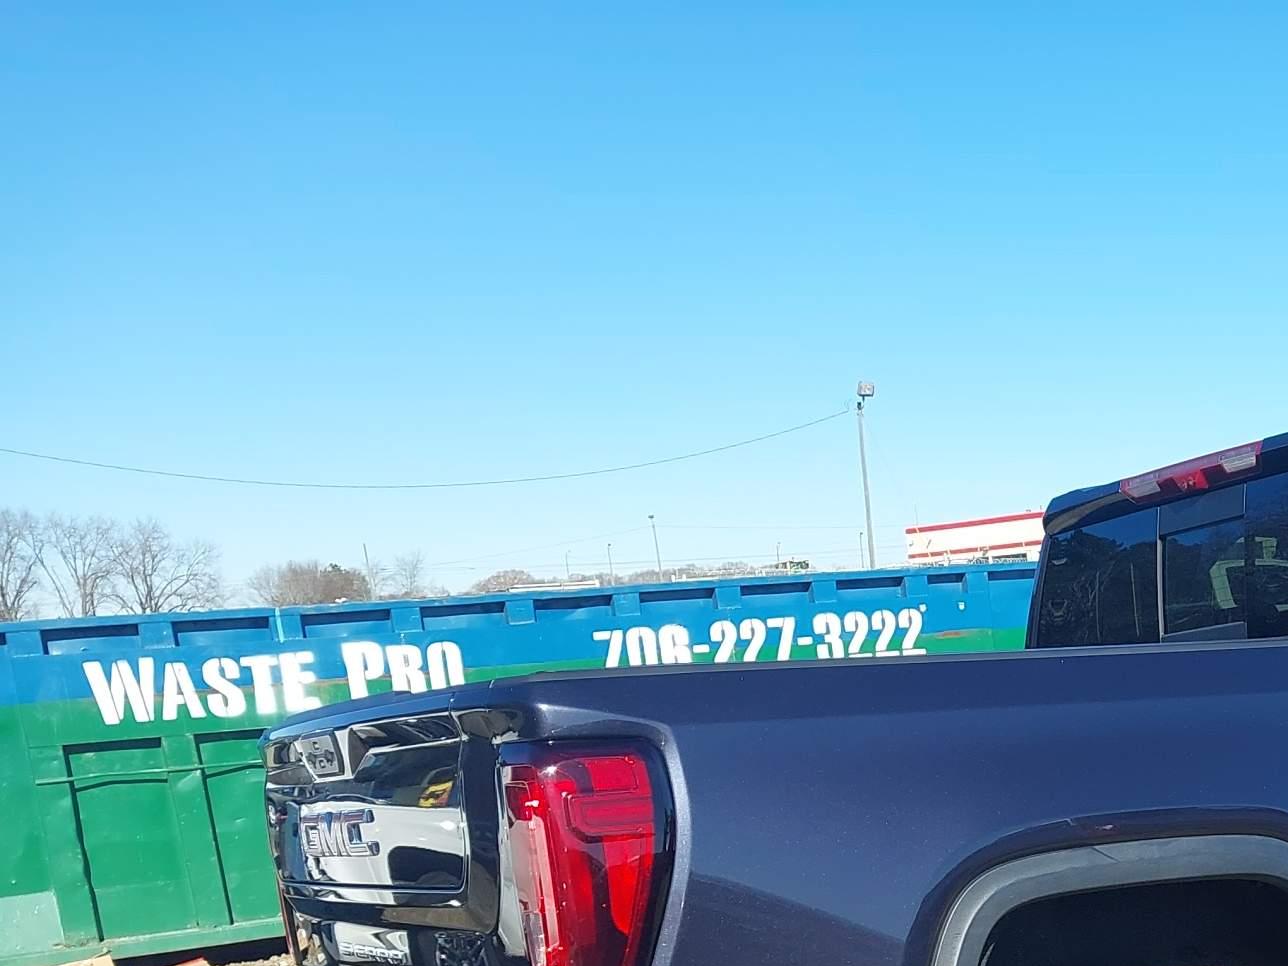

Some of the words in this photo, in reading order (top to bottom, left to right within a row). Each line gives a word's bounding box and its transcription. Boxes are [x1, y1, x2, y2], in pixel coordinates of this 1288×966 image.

[593, 607, 926, 668] 706-227-3222
[82, 650, 323, 725] WASTE
[340, 640, 465, 699] PRO
[301, 809, 380, 857] GMC
